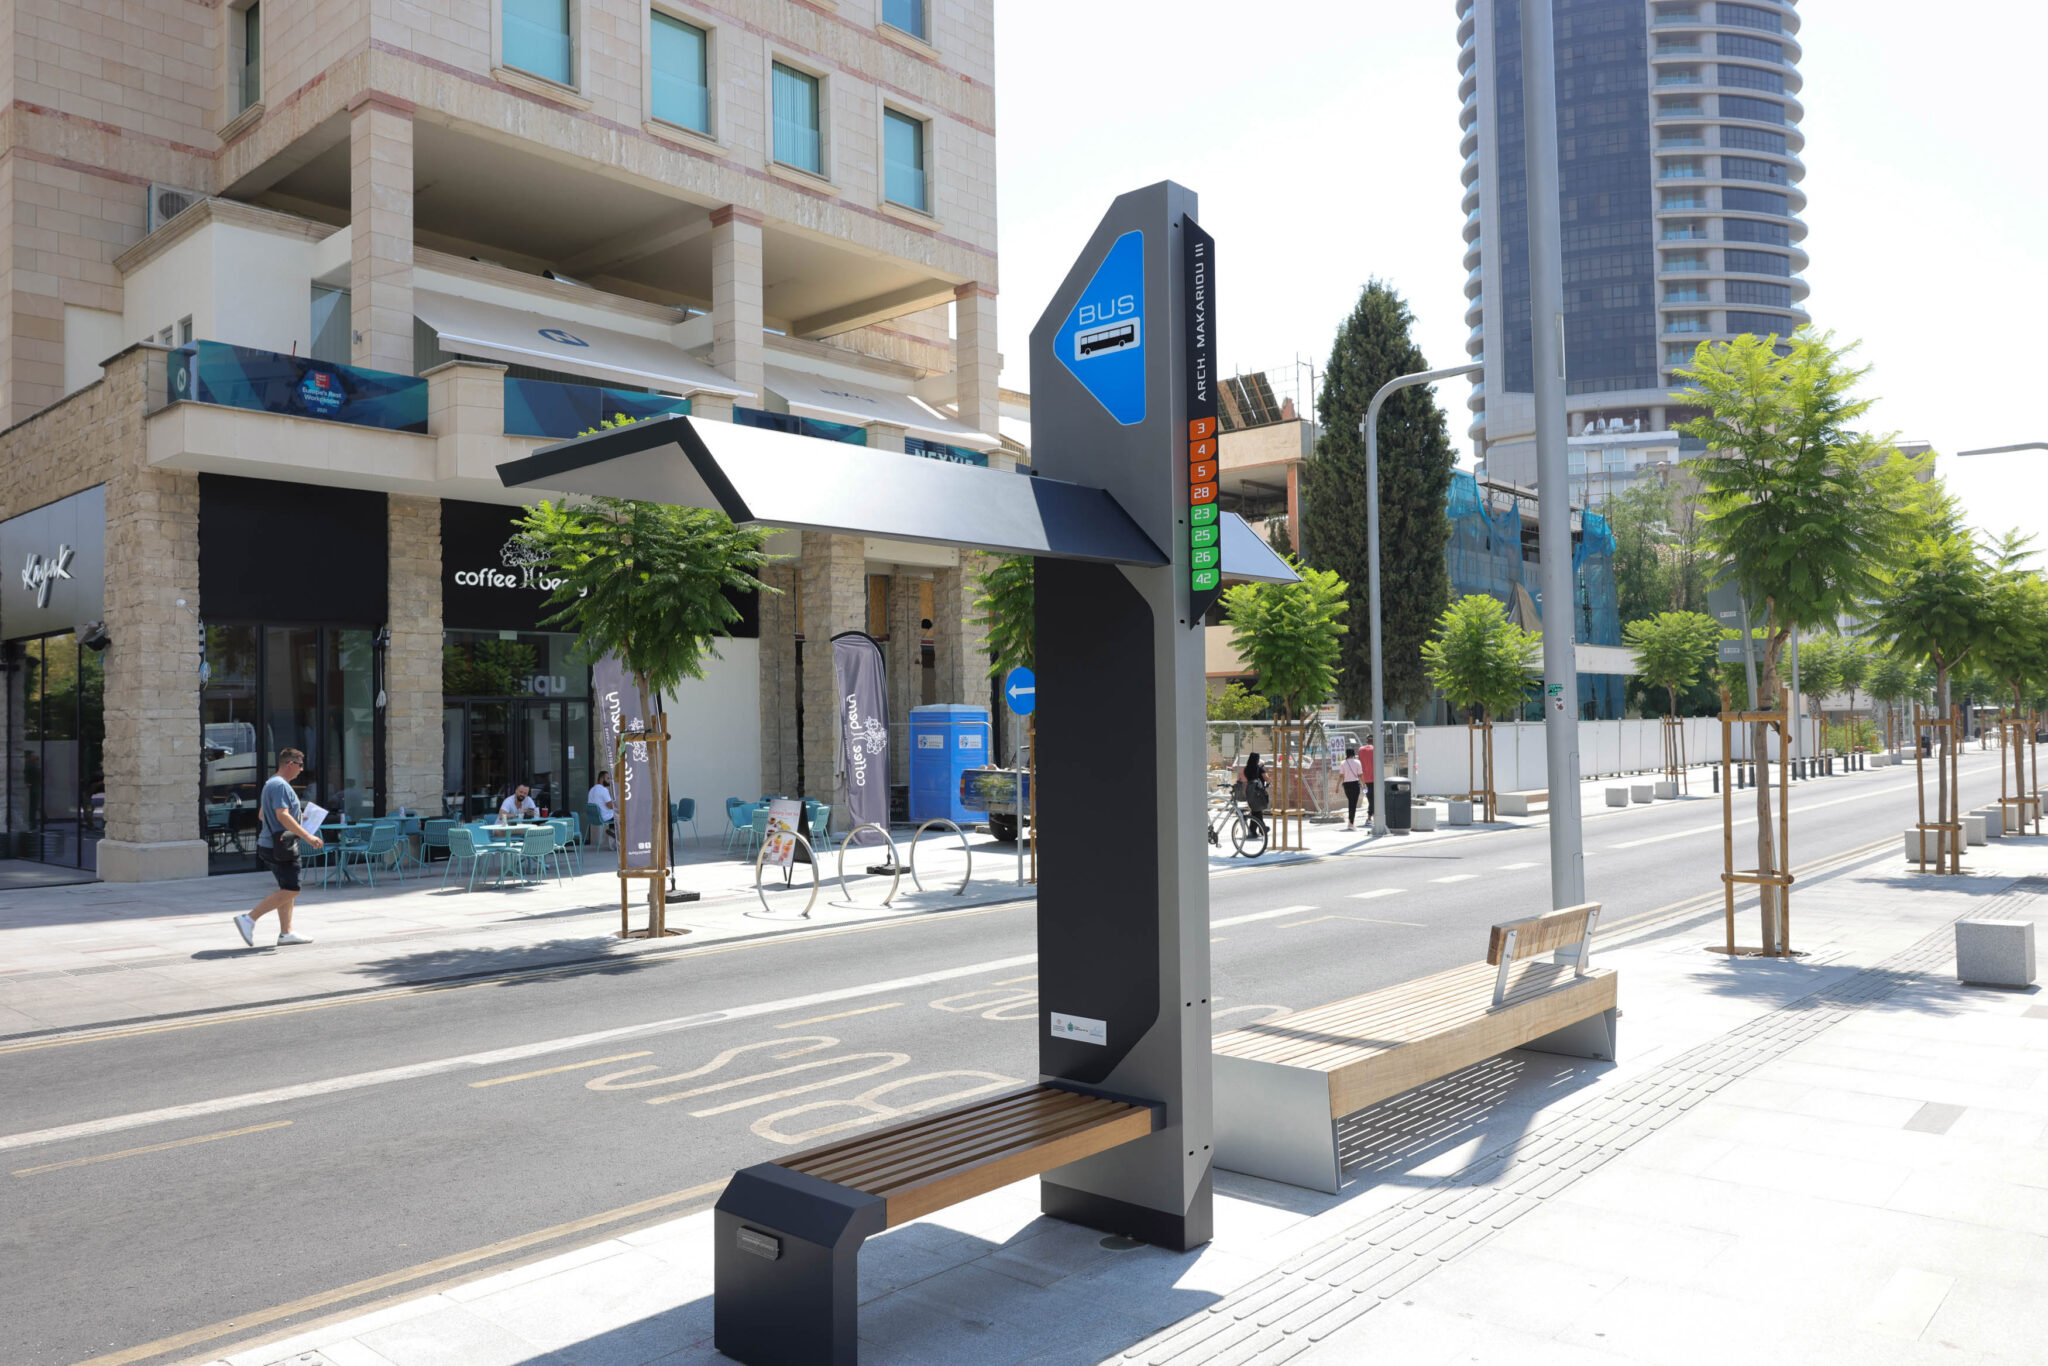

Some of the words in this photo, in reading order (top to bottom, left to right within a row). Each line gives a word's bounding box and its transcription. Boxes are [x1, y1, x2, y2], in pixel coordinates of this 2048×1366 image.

[1195, 243, 1204, 257] III
[1079, 294, 1135, 326] BUS
[1195, 262, 1205, 348] MAKARIOU
[1196, 353, 1206, 402] ARCH.
[1197, 422, 1205, 434] 3
[1197, 444, 1206, 455] 4
[1197, 465, 1206, 477] 5
[1193, 487, 1209, 499] 28
[1194, 508, 1210, 520] 23
[1194, 530, 1210, 542] 25
[1195, 551, 1211, 563] 26
[454, 568, 517, 588] coffee
[1195, 572, 1211, 585] 42
[584, 1035, 1027, 1145] BUS
